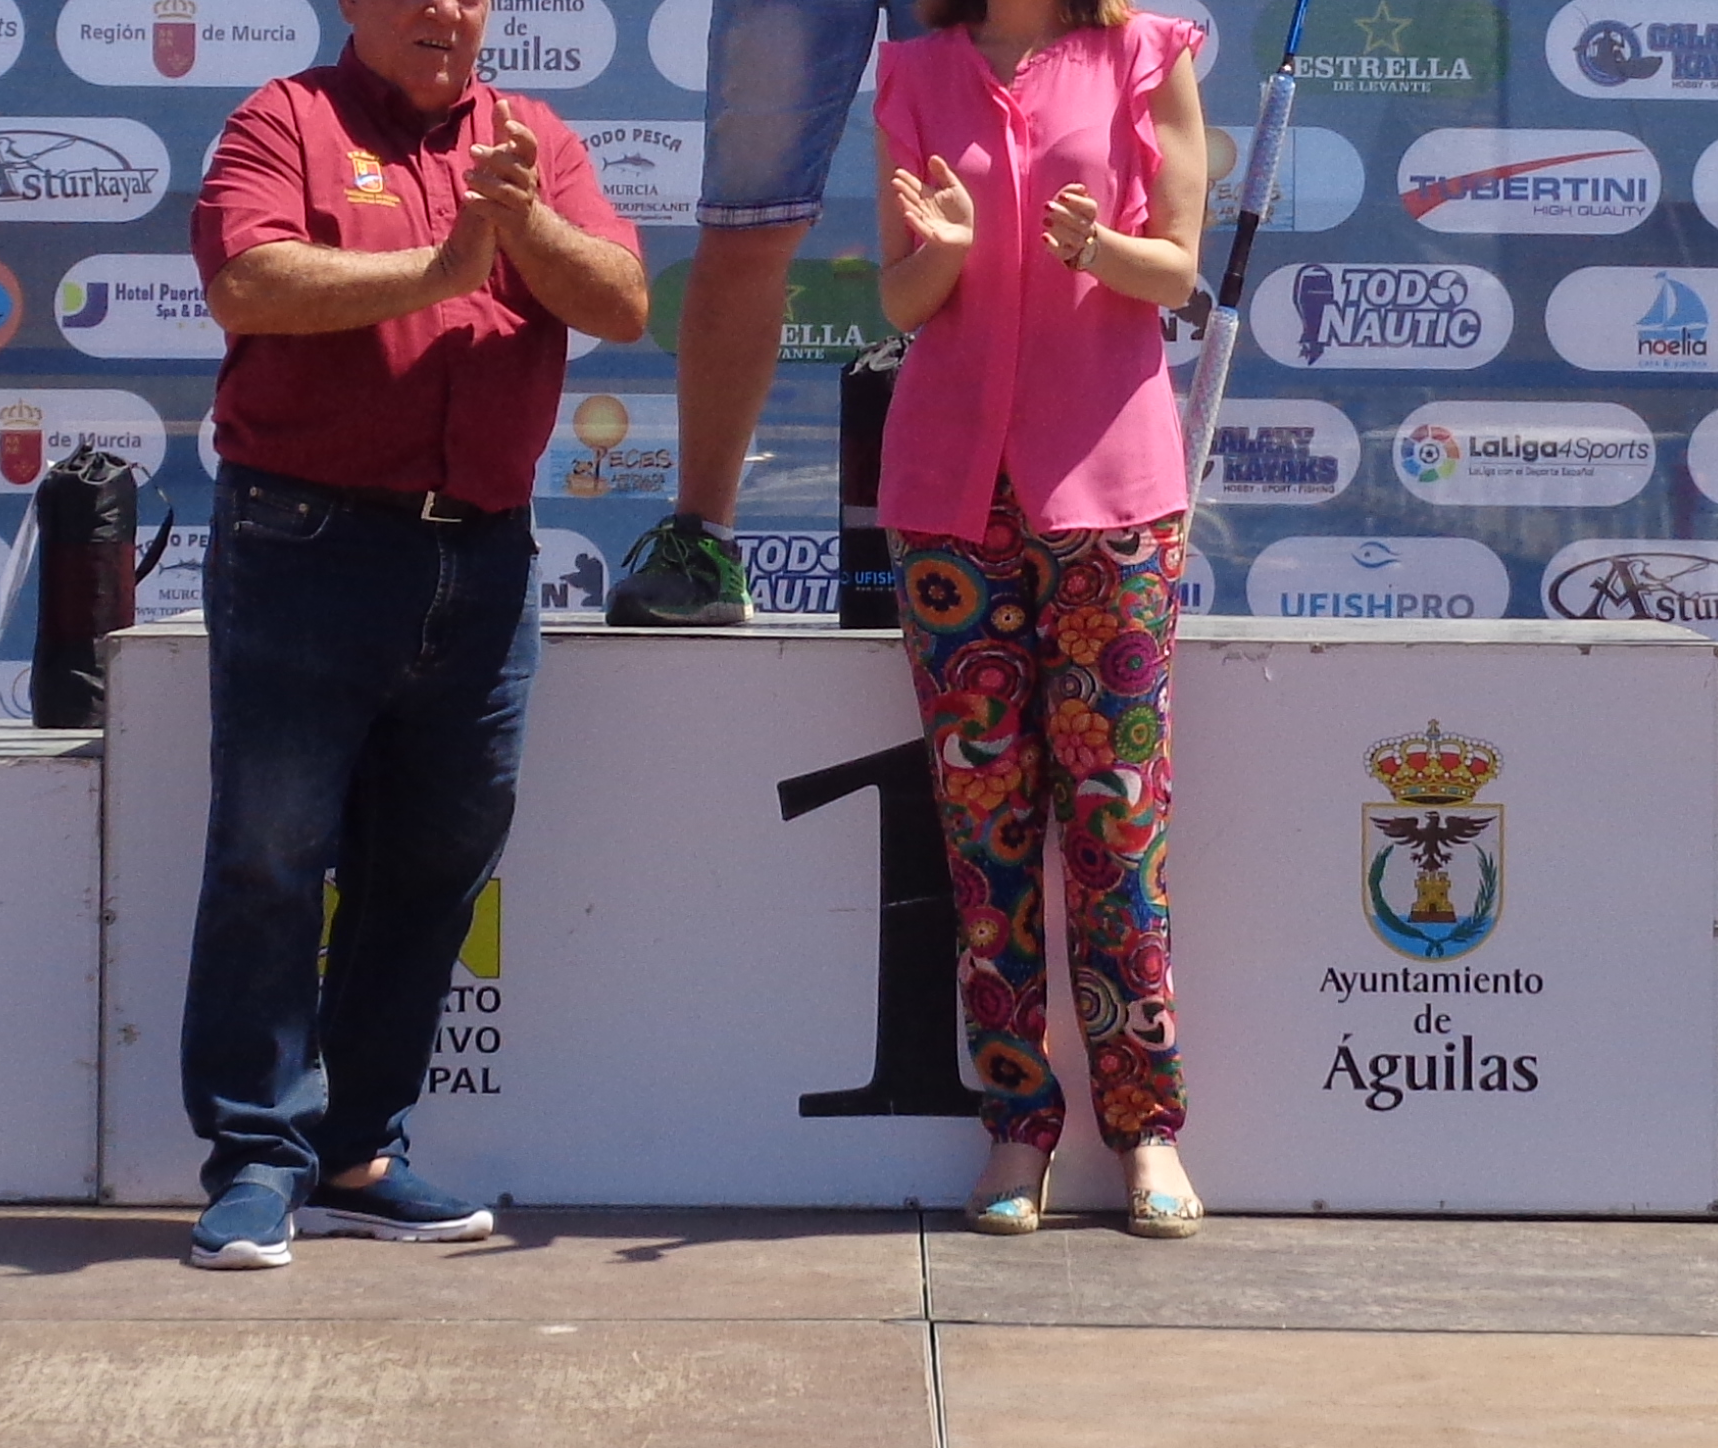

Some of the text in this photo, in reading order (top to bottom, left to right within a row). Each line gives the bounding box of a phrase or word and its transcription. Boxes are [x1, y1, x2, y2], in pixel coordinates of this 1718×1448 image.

[80, 25, 296, 45] Región de Murcia
[504, 17, 528, 37] de
[1294, 55, 1472, 81] ESTRELLA
[1333, 81, 1432, 93] DE LEVANTE
[632, 128, 683, 153] PESCA
[603, 184, 659, 196] MURCIA
[1409, 174, 1647, 201] TUBERTINI
[1533, 205, 1646, 218] HIGH QUALITY
[115, 282, 154, 301] Hotel
[156, 304, 176, 320] Spa
[1317, 302, 1482, 349] NAUTIC
[1637, 326, 1707, 356] noelia
[48, 430, 72, 449] de
[1469, 435, 1649, 463] LaLiga4Sports
[1319, 966, 1544, 999] Ayuntamiento
[1414, 1005, 1452, 1036] de
[1323, 1033, 1539, 1112] Águilas
